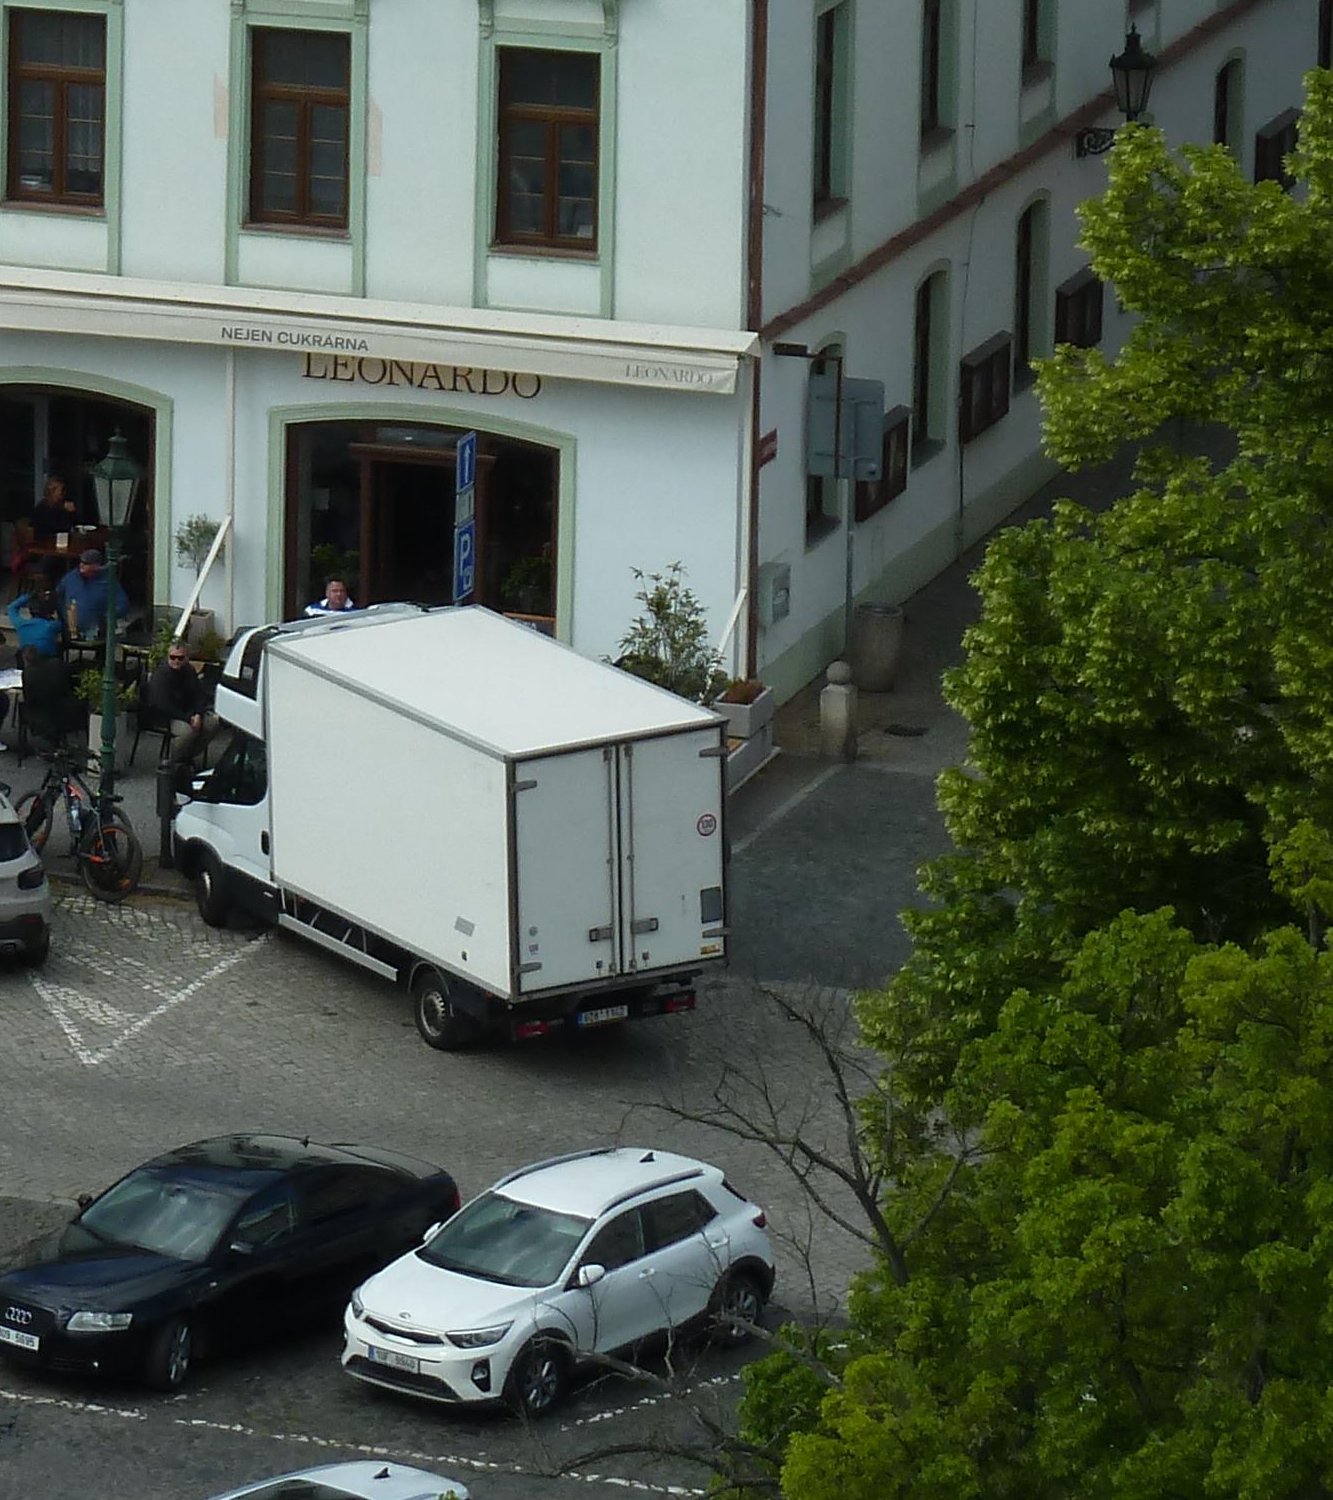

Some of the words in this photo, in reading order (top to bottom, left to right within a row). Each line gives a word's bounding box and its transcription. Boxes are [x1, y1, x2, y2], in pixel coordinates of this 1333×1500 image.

[220, 326, 273, 343] NEJEN
[277, 329, 369, 352] CUKRÁRNA
[301, 352, 542, 400] LEONARDO
[624, 363, 714, 386] LEONARDO
